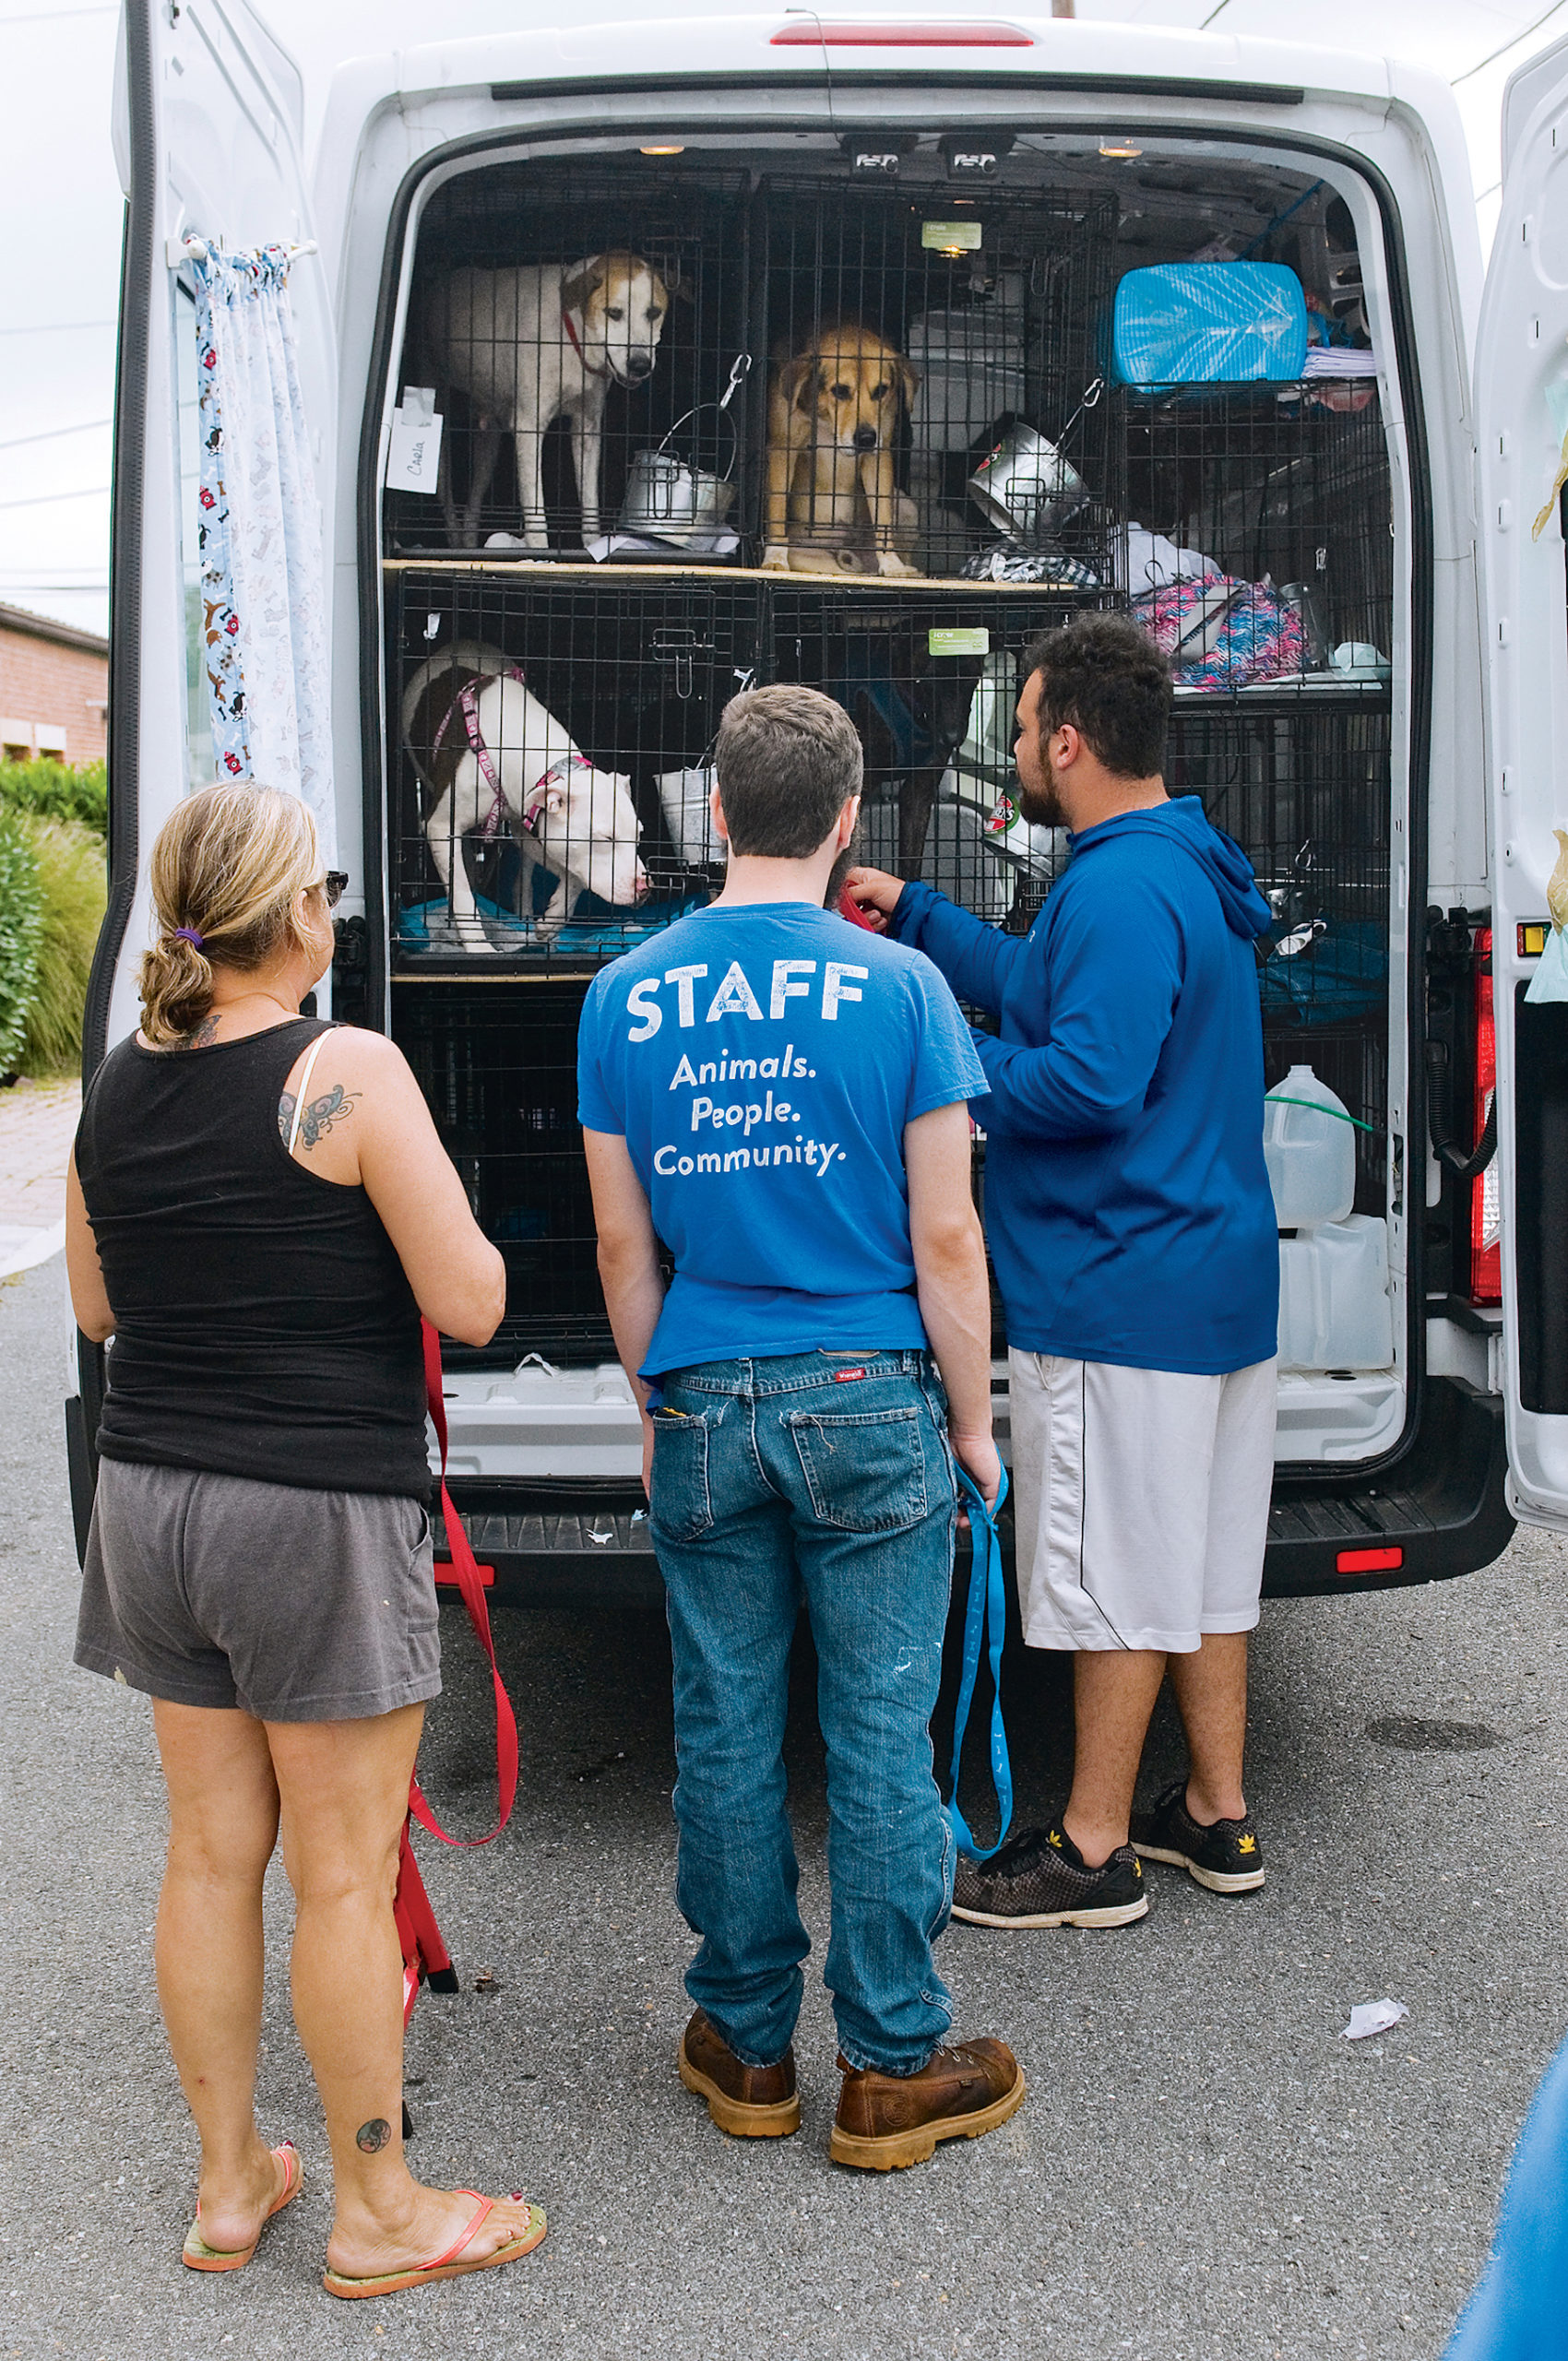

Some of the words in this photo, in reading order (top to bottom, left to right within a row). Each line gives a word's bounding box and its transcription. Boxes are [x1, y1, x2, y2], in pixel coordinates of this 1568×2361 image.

[626, 960, 869, 1042] STAFF
[669, 1044, 816, 1090] Animals.
[692, 1090, 801, 1135] People.
[654, 1134, 847, 1177] Community.
